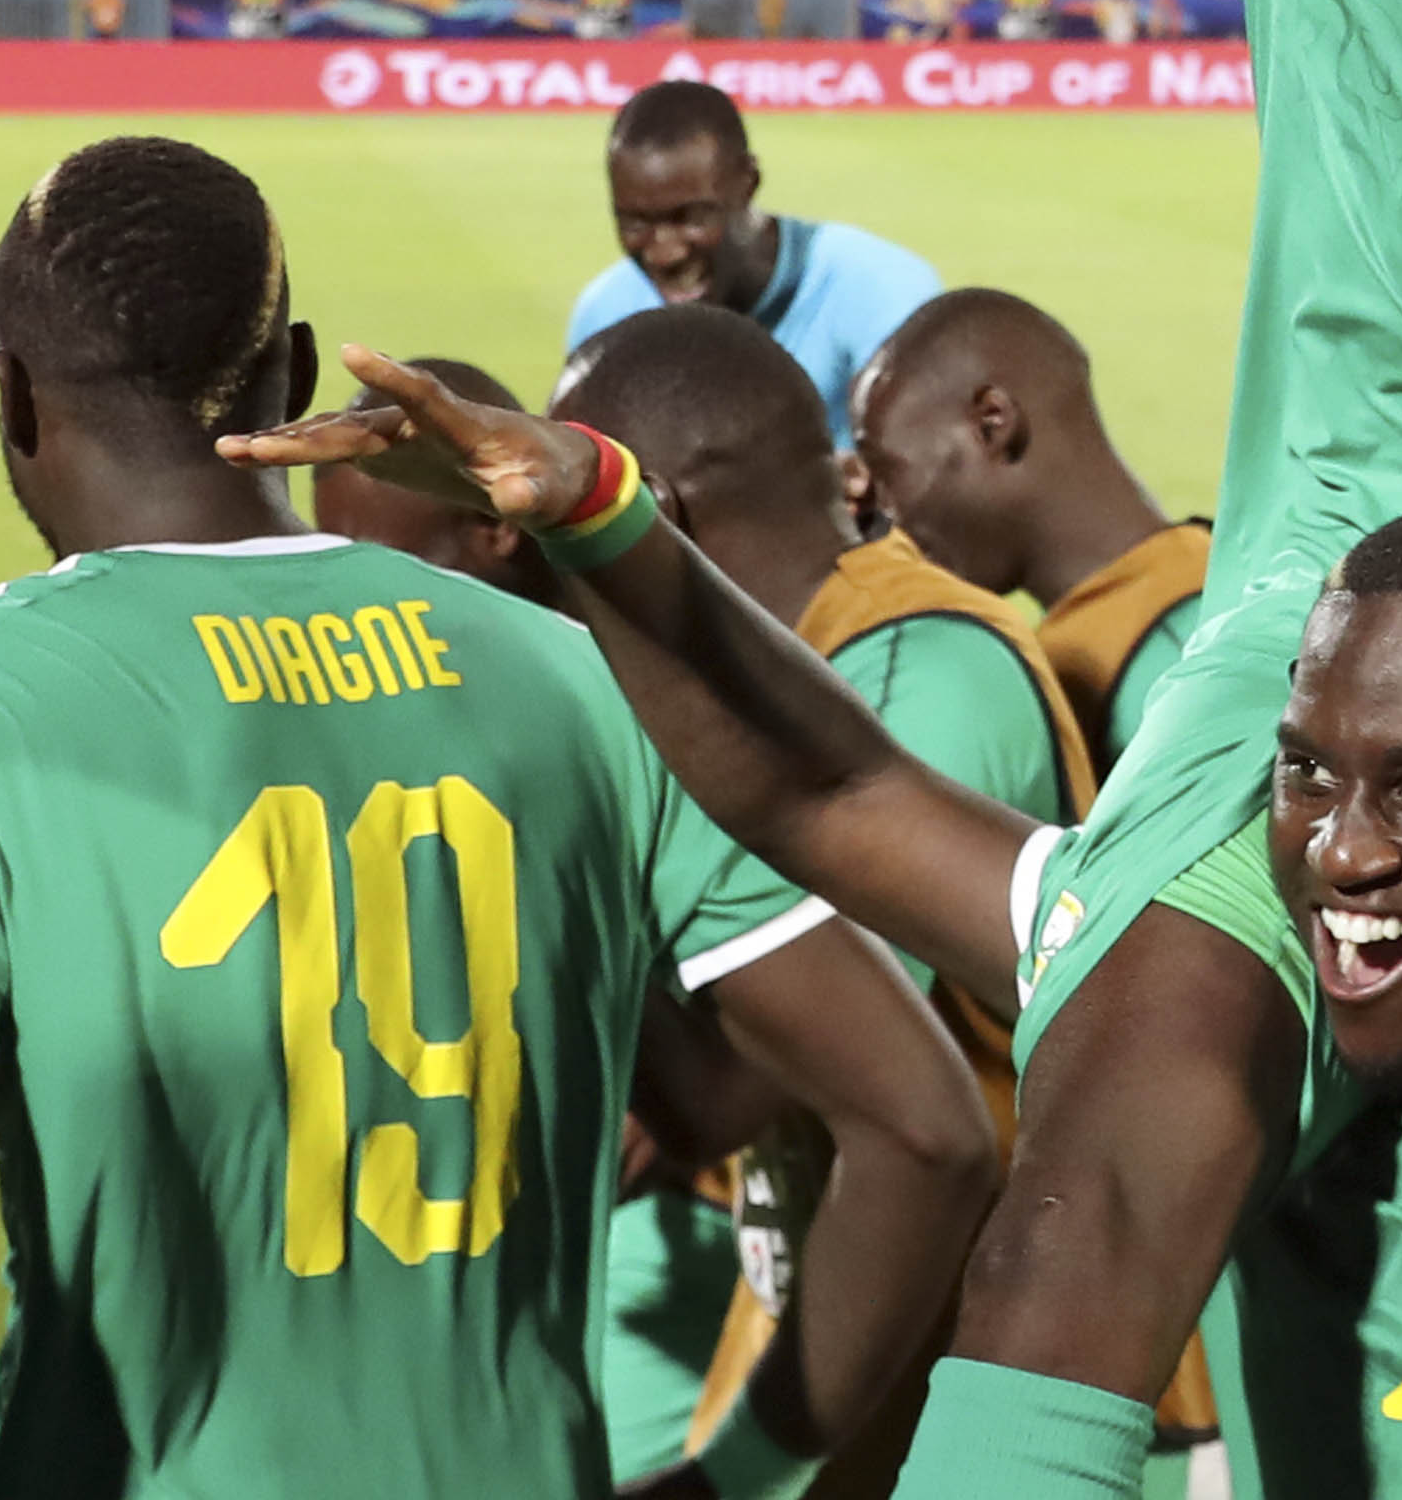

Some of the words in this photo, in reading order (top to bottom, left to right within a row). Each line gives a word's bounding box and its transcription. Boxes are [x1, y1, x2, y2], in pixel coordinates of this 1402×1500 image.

[387, 50, 632, 106] TOTAL
[902, 51, 1034, 106] CUP
[1049, 60, 1130, 106] OF
[193, 600, 462, 704] DIAGNE
[160, 774, 521, 1277] 19
